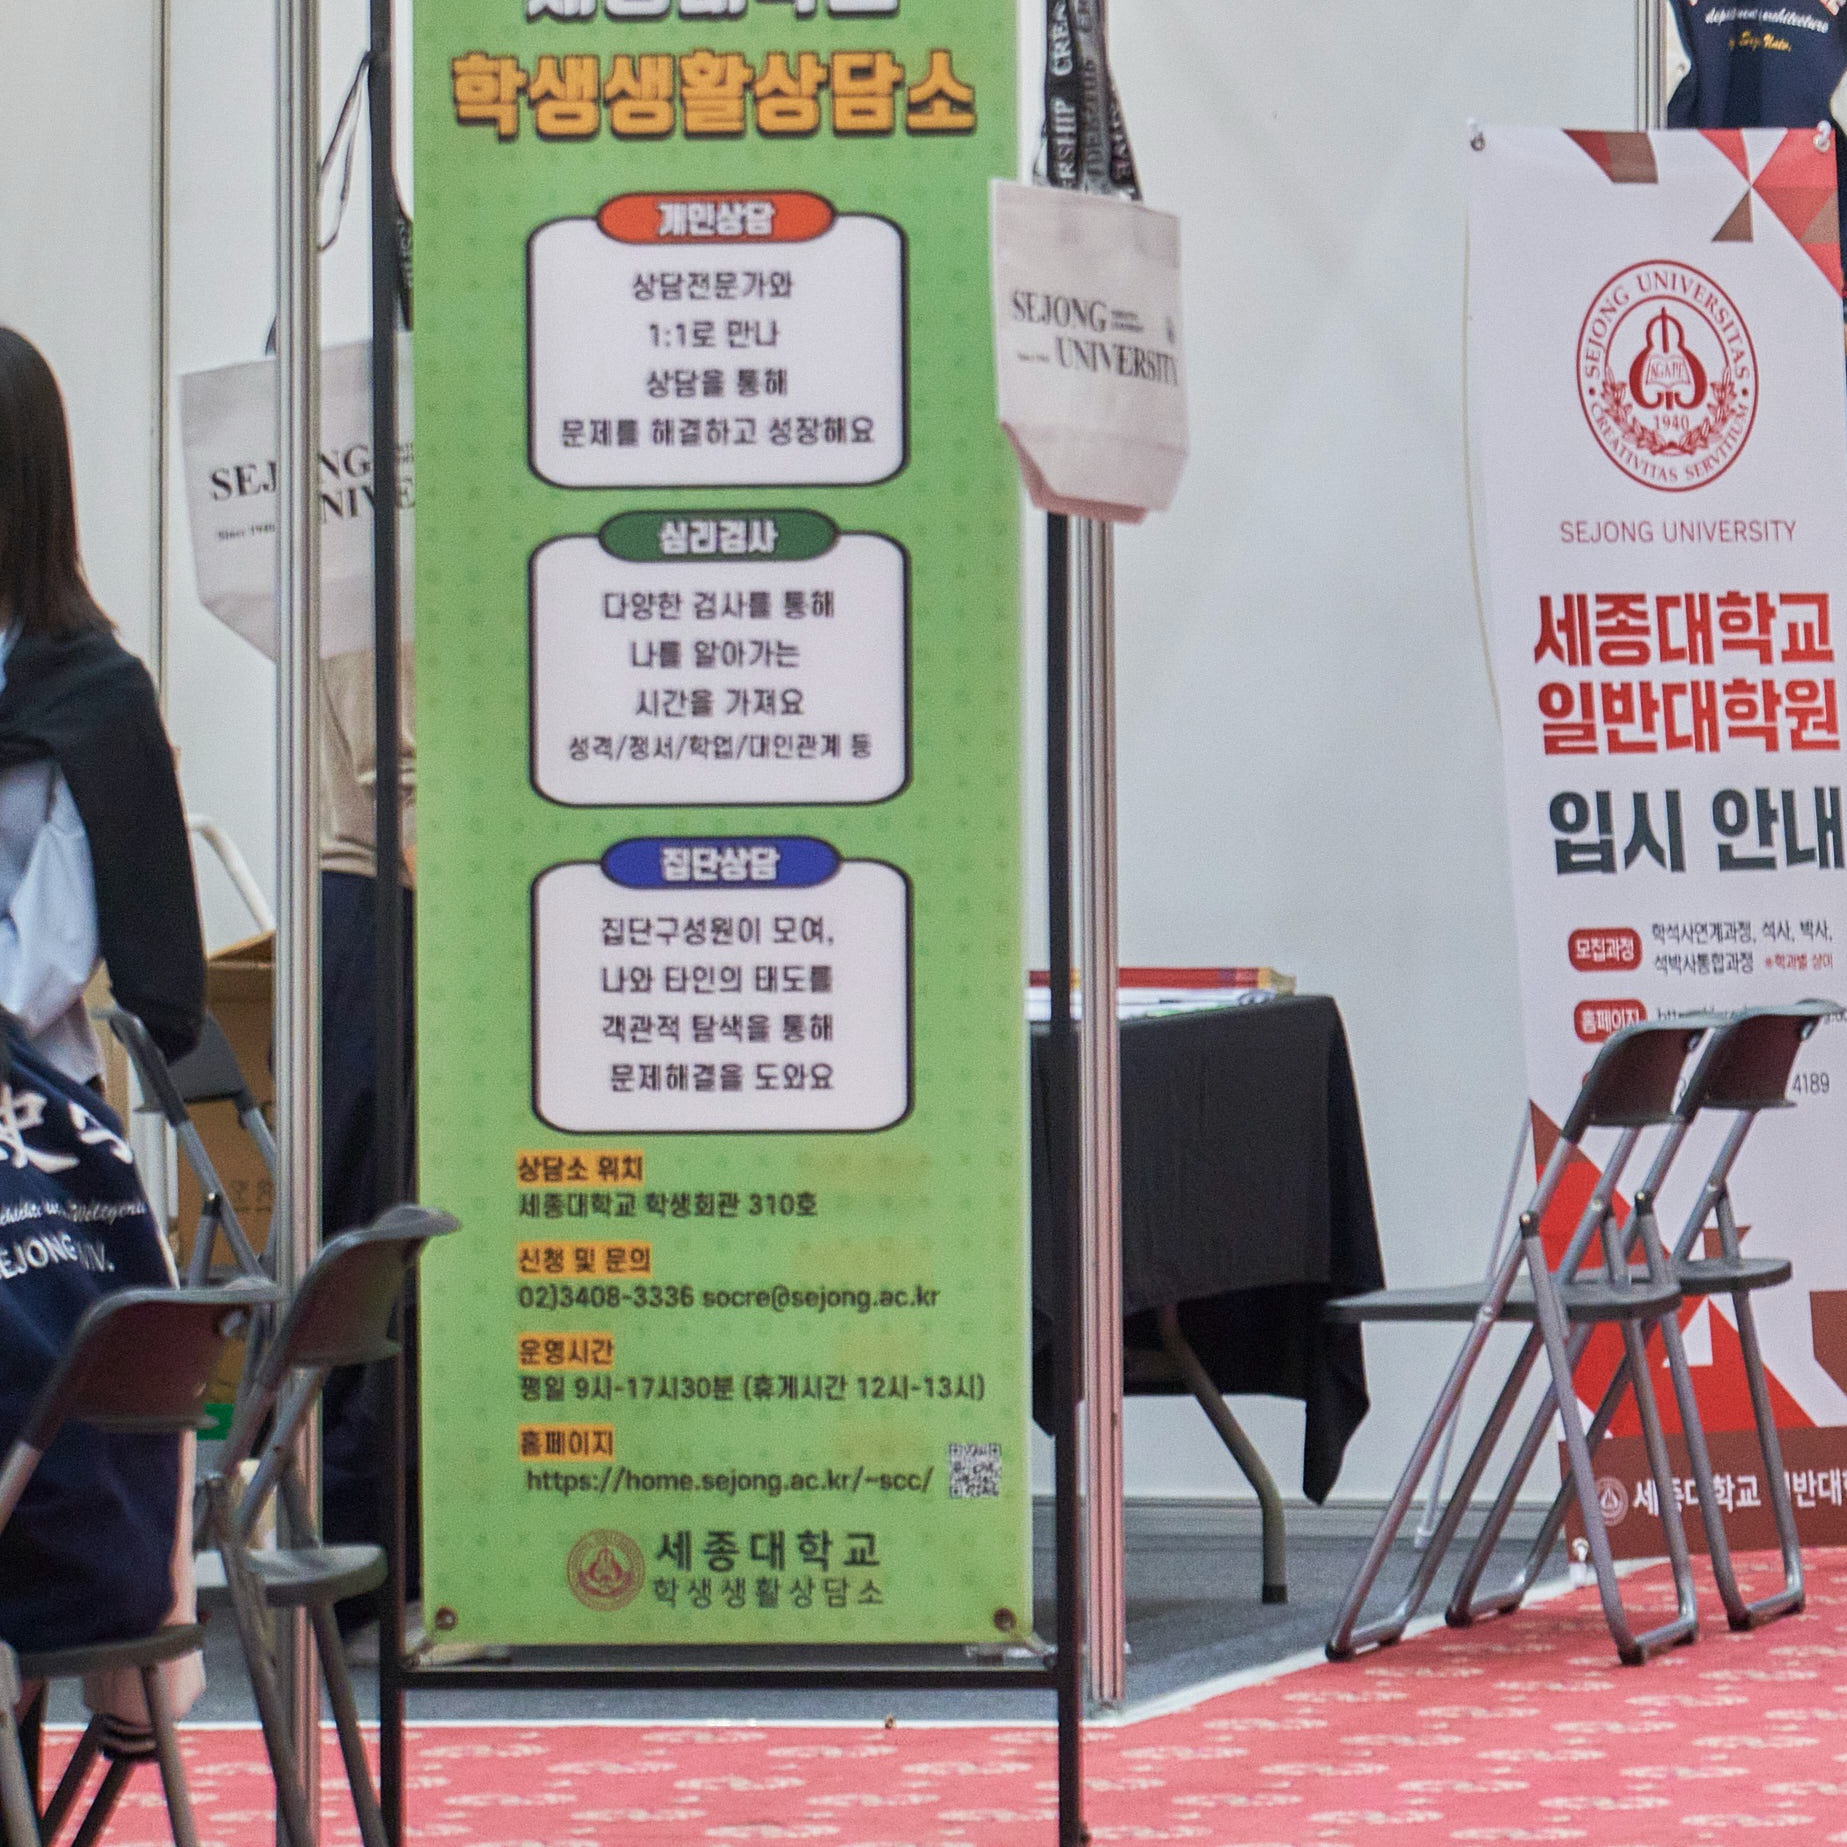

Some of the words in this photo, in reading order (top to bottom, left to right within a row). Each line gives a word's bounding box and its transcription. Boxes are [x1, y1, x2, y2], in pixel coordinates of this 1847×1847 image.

[451, 47, 976, 141] 학생생활상담소
[658, 201, 775, 237] 개인상담
[632, 272, 793, 301] 상담전문가와
[1012, 289, 1107, 333] SEJONG
[1585, 285, 1630, 379] SEJONG
[1636, 270, 1750, 380] UNIVERSITAS
[649, 320, 716, 349] 1:1로
[726, 319, 779, 349] 만나
[646, 368, 726, 398] 상담을
[737, 367, 788, 397] 통해
[562, 418, 639, 448] 문제를
[652, 418, 757, 447] 해결하고
[768, 416, 875, 445] 성장해요
[1653, 414, 1690, 431] 1940
[1591, 402, 1678, 482] CREATIVITAS
[210, 442, 374, 502] SEJNG
[659, 519, 778, 555] 심리검사
[1560, 519, 1654, 544] SEJONG
[1662, 517, 1797, 543] UNIVERSITY
[603, 591, 683, 621] 다양한
[693, 590, 773, 620] 검사를
[783, 590, 834, 620] 통해
[1534, 590, 1836, 668] 세종대학교
[629, 641, 682, 670] 나를
[693, 640, 800, 670] 알아가는
[635, 690, 714, 719] 시간을
[725, 688, 804, 718] 가져요
[1538, 677, 1842, 756] 일반대학원
[1548, 788, 1687, 877] 입시
[1711, 784, 1846, 873] 안내
[661, 846, 781, 883] 집단상담
[602, 918, 762, 948] 집단구성원이
[773, 917, 834, 947] 모여,
[1761, 920, 1796, 943] 석사,
[1800, 919, 1834, 943] 박사,
[1575, 938, 1634, 962] 모집과정
[601, 965, 653, 995] 나와
[664, 965, 742, 995] 타인의
[754, 964, 833, 994] 태도를
[602, 1016, 681, 1043] 객관적
[692, 1015, 771, 1043] 탐색을
[782, 1014, 833, 1042] 통해
[611, 1063, 743, 1093] 문제해결을
[755, 1063, 834, 1091] 도와요
[518, 1156, 590, 1183] 상담소
[599, 1155, 644, 1182] 위치
[518, 1191, 636, 1220] 세종대학교
[645, 1191, 740, 1219] 학생회관
[748, 1191, 818, 1218] 310호
[518, 1246, 564, 1275] 신청
[574, 1246, 596, 1274] 및
[605, 1246, 651, 1274] 문의
[518, 1286, 694, 1312] 02)3408-3336
[702, 1286, 940, 1313] socre@sejong.ac.kr
[520, 1338, 614, 1367] 운영시간
[520, 1376, 565, 1404] 평일
[574, 1375, 734, 1403] 9시-17시30분
[743, 1374, 846, 1403] (휴게시간
[857, 1374, 985, 1403] 12시-13시)
[521, 1429, 615, 1458] 홈페이지
[655, 1530, 881, 1573] 세종대학교
[653, 1578, 885, 1610] 학생생활상담소
